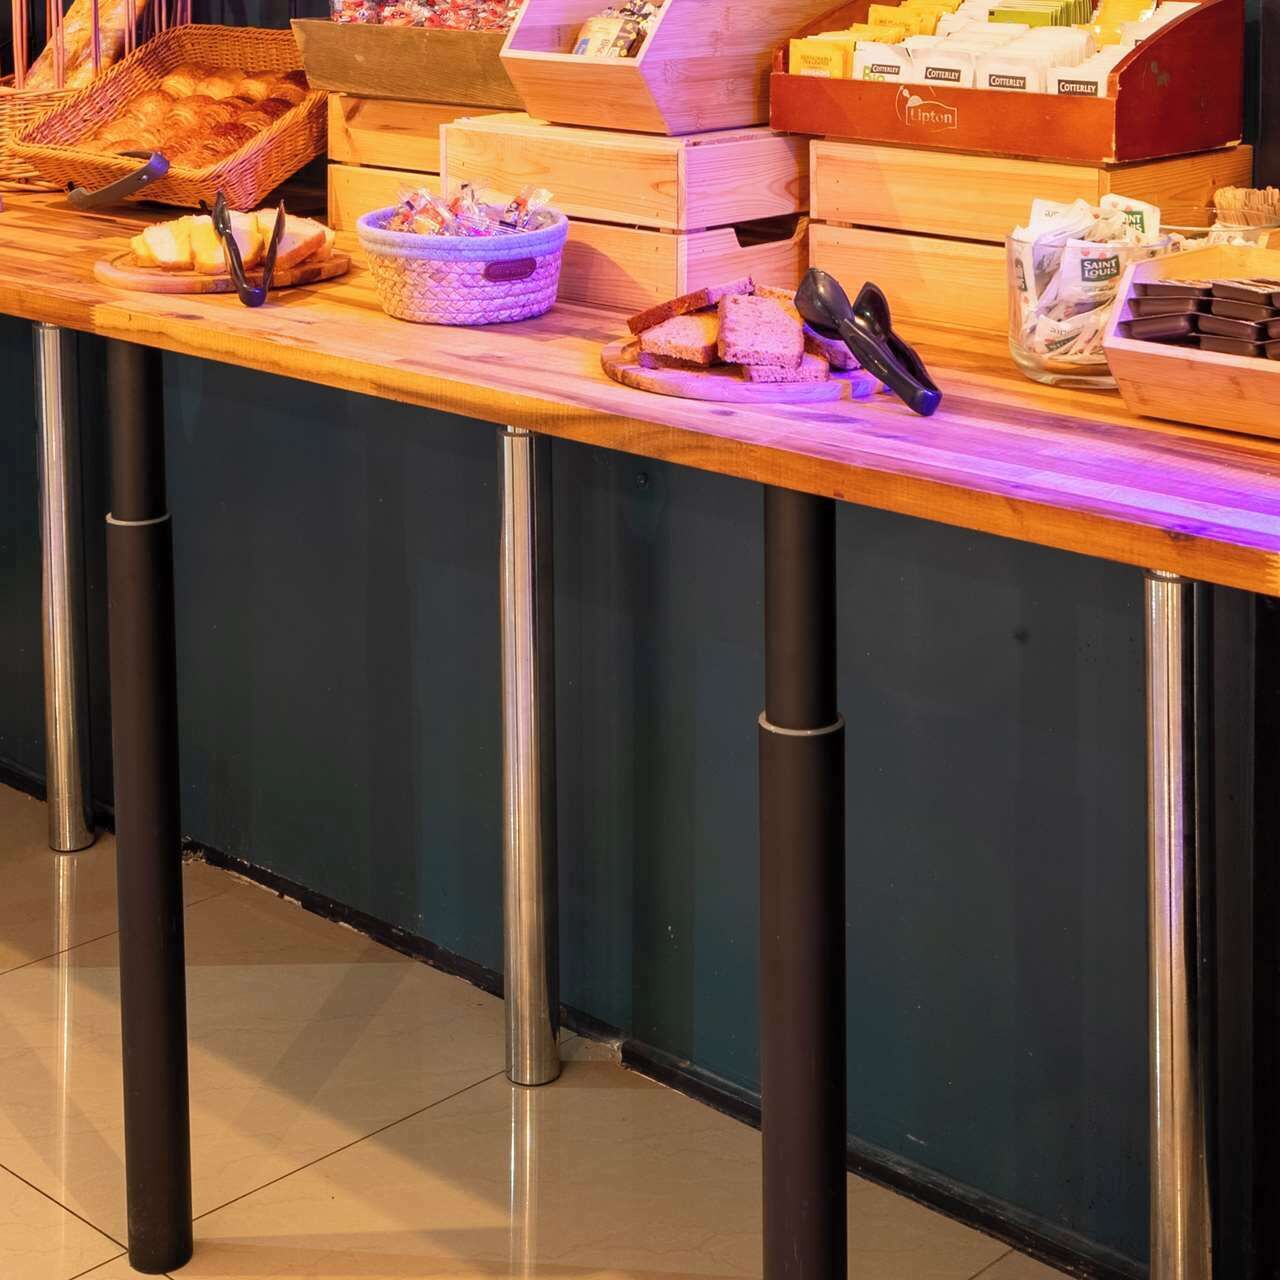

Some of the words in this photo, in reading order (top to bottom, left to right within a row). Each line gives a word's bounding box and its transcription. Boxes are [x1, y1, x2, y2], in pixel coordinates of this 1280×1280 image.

[872, 64, 900, 74] COTTERLEY
[926, 67, 960, 81] COTTERLEY
[990, 75, 1025, 88] COTTERLEY
[1059, 81, 1097, 94] COTTERLEY
[910, 108, 953, 125] Lipton
[1082, 258, 1118, 270] SAINT
[1084, 267, 1118, 278] LOUIS
